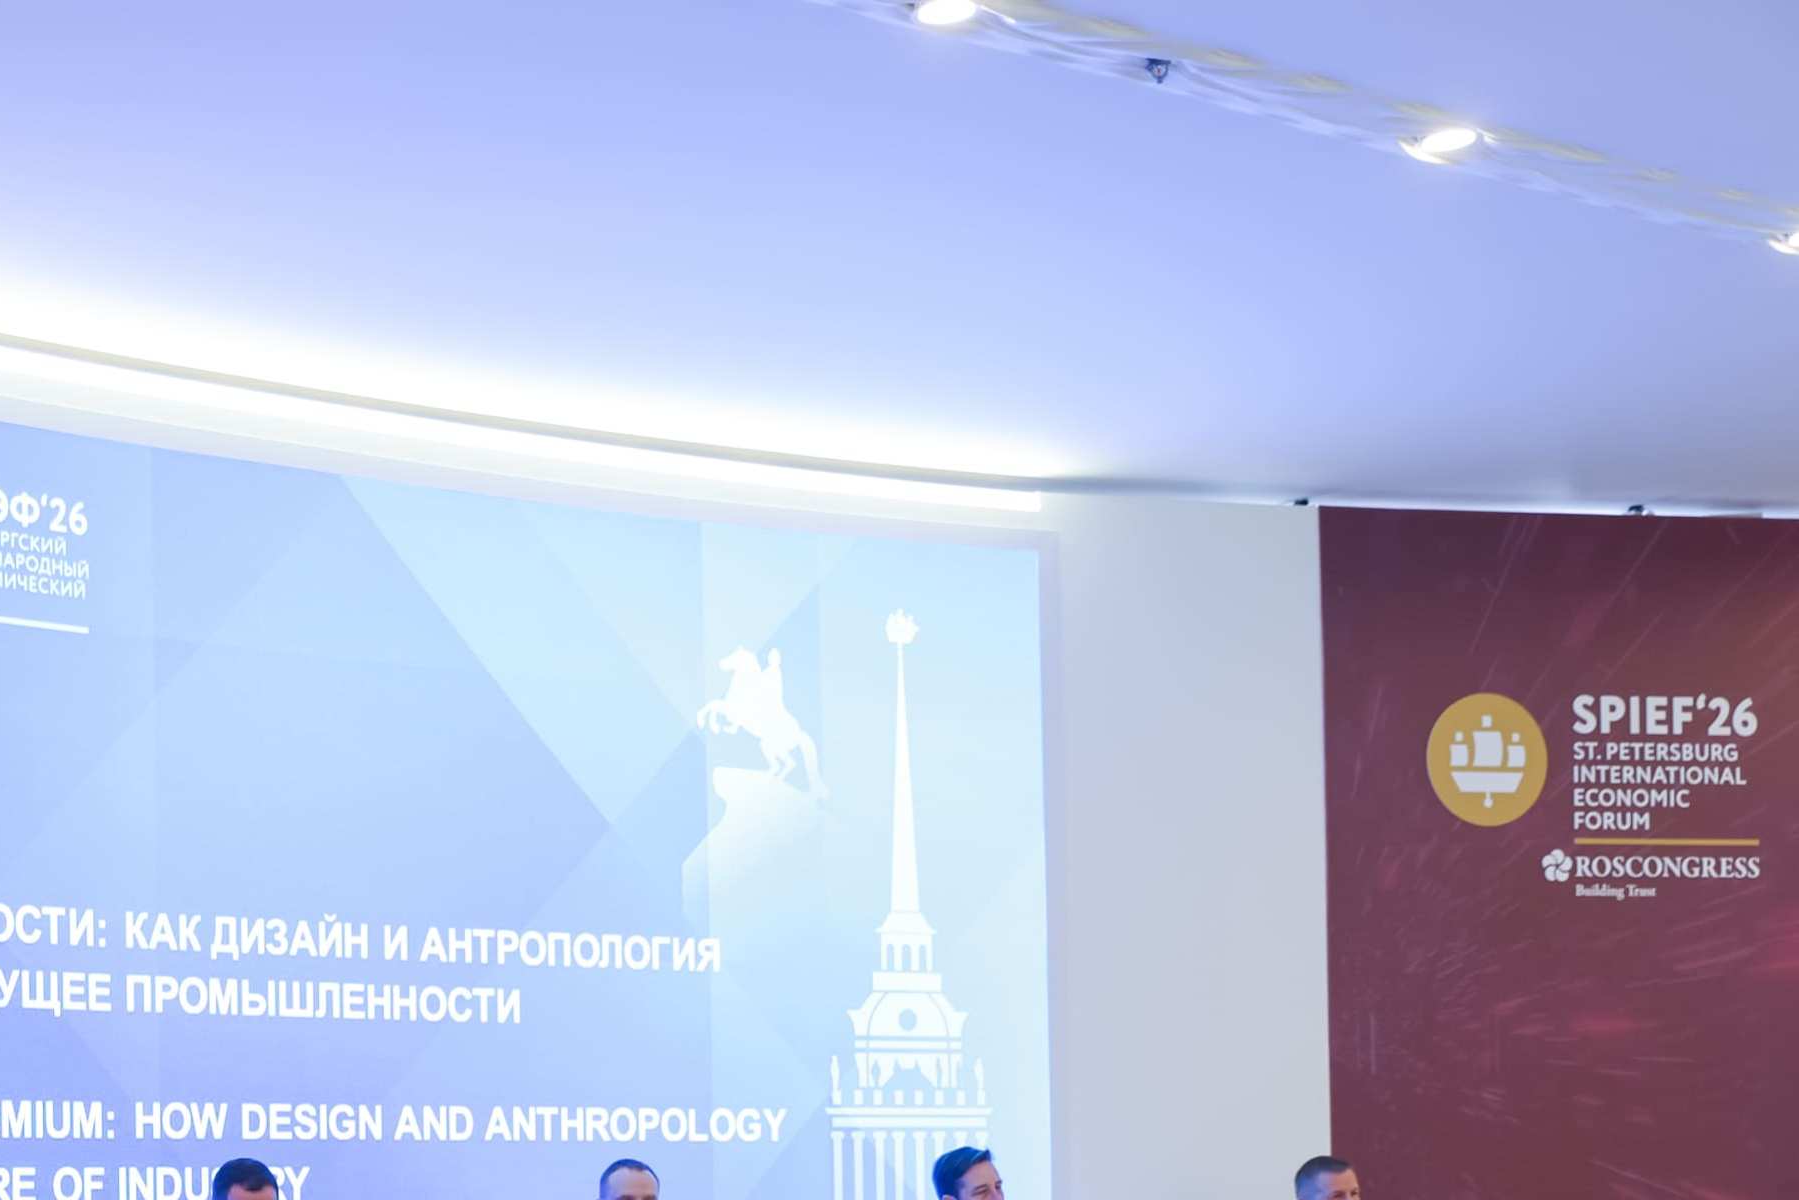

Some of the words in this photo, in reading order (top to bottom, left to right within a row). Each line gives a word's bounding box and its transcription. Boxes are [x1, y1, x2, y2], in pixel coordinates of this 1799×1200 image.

[1572, 693, 1758, 737] SPIEF'26
[1573, 741, 1601, 761] ST.
[1606, 742, 1739, 762] PETERSBURG
[1573, 765, 1747, 785] INTERNATIONAL
[1573, 788, 1690, 808] ECONOMIC
[1573, 811, 1650, 831] FORUM
[1575, 855, 1761, 879] ROSCONGRESS
[1575, 884, 1625, 901] Building
[1627, 884, 1657, 897] Trust
[125, 911, 201, 951] КАК
[211, 914, 369, 960] ДИЗАЙН
[384, 925, 408, 962] И
[420, 927, 721, 972] АНТРОПОЛОГИЯ
[126, 974, 521, 1023] ПРОМЫШЛЕННОСТИ
[135, 1101, 228, 1141] HOW
[241, 1102, 383, 1141] DESIGN
[394, 1104, 473, 1141] AND
[485, 1106, 787, 1142] ANTHROPOLOGY
